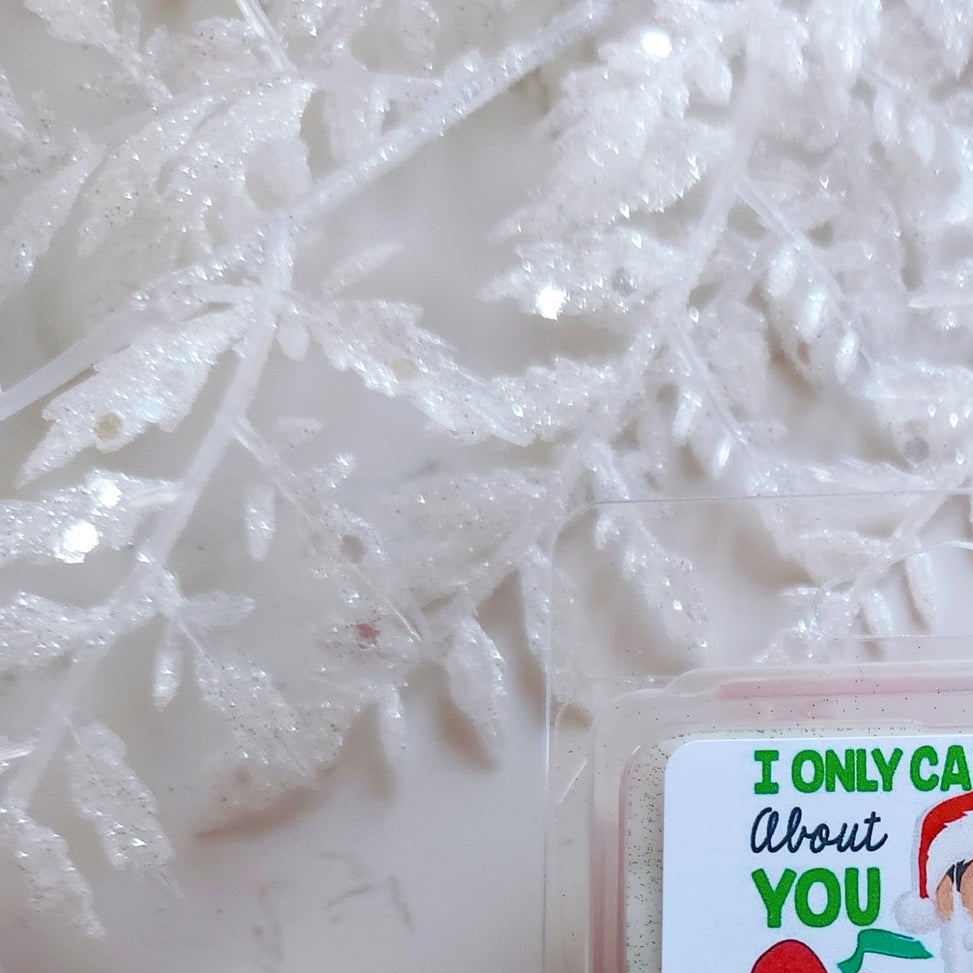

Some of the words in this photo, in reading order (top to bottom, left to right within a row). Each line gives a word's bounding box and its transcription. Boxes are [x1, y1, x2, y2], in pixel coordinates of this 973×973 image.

[754, 750, 779, 794] I
[791, 748, 903, 793] ONLY
[751, 807, 888, 853] About
[751, 867, 880, 928] YOU
